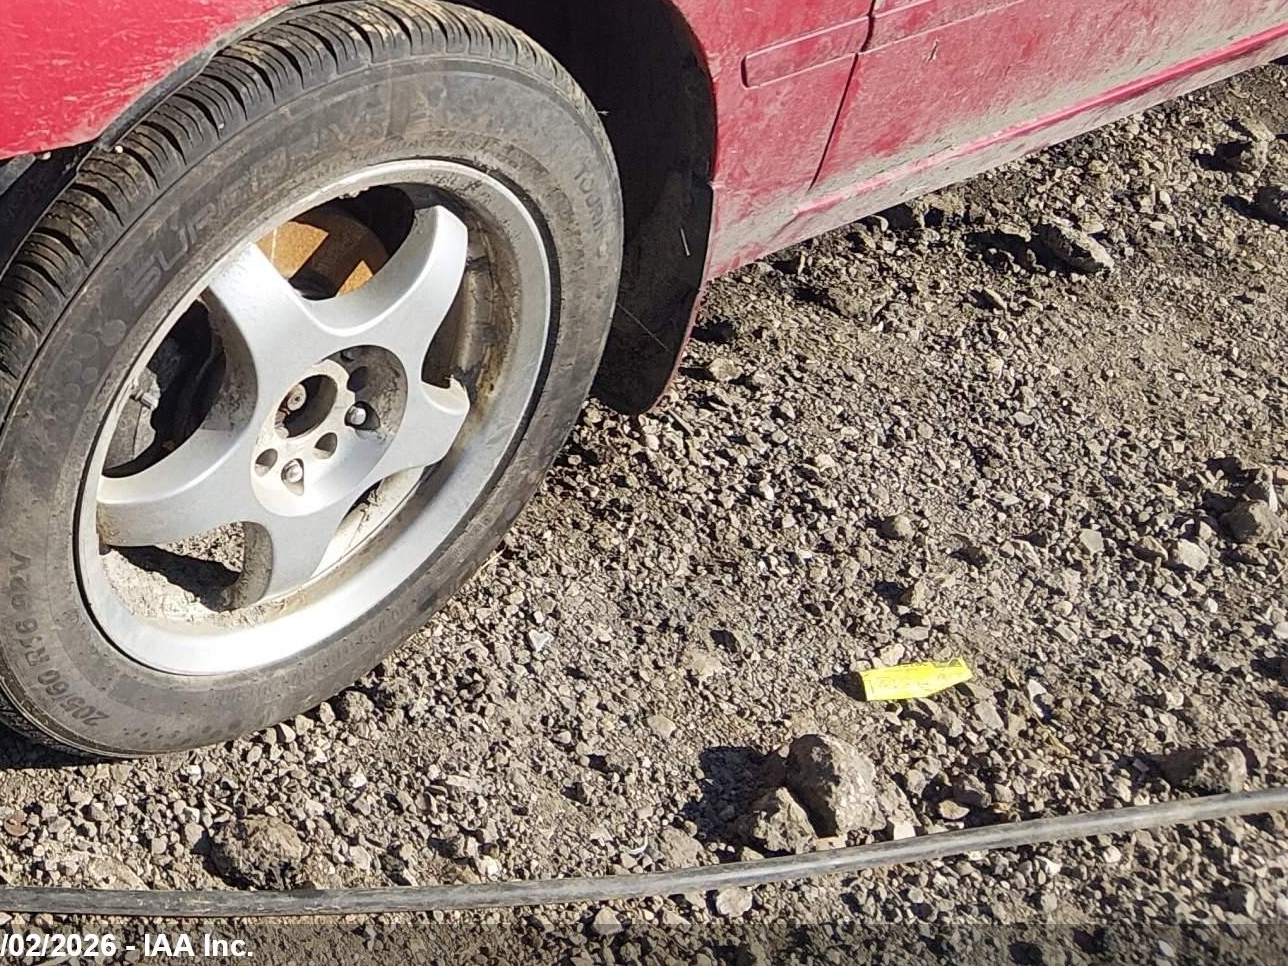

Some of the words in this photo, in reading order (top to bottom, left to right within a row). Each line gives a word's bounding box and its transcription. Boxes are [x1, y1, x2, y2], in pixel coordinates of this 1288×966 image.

[10, 551, 33, 611] 92V
[15, 617, 51, 667] R16
[36, 669, 111, 727] 205/60
